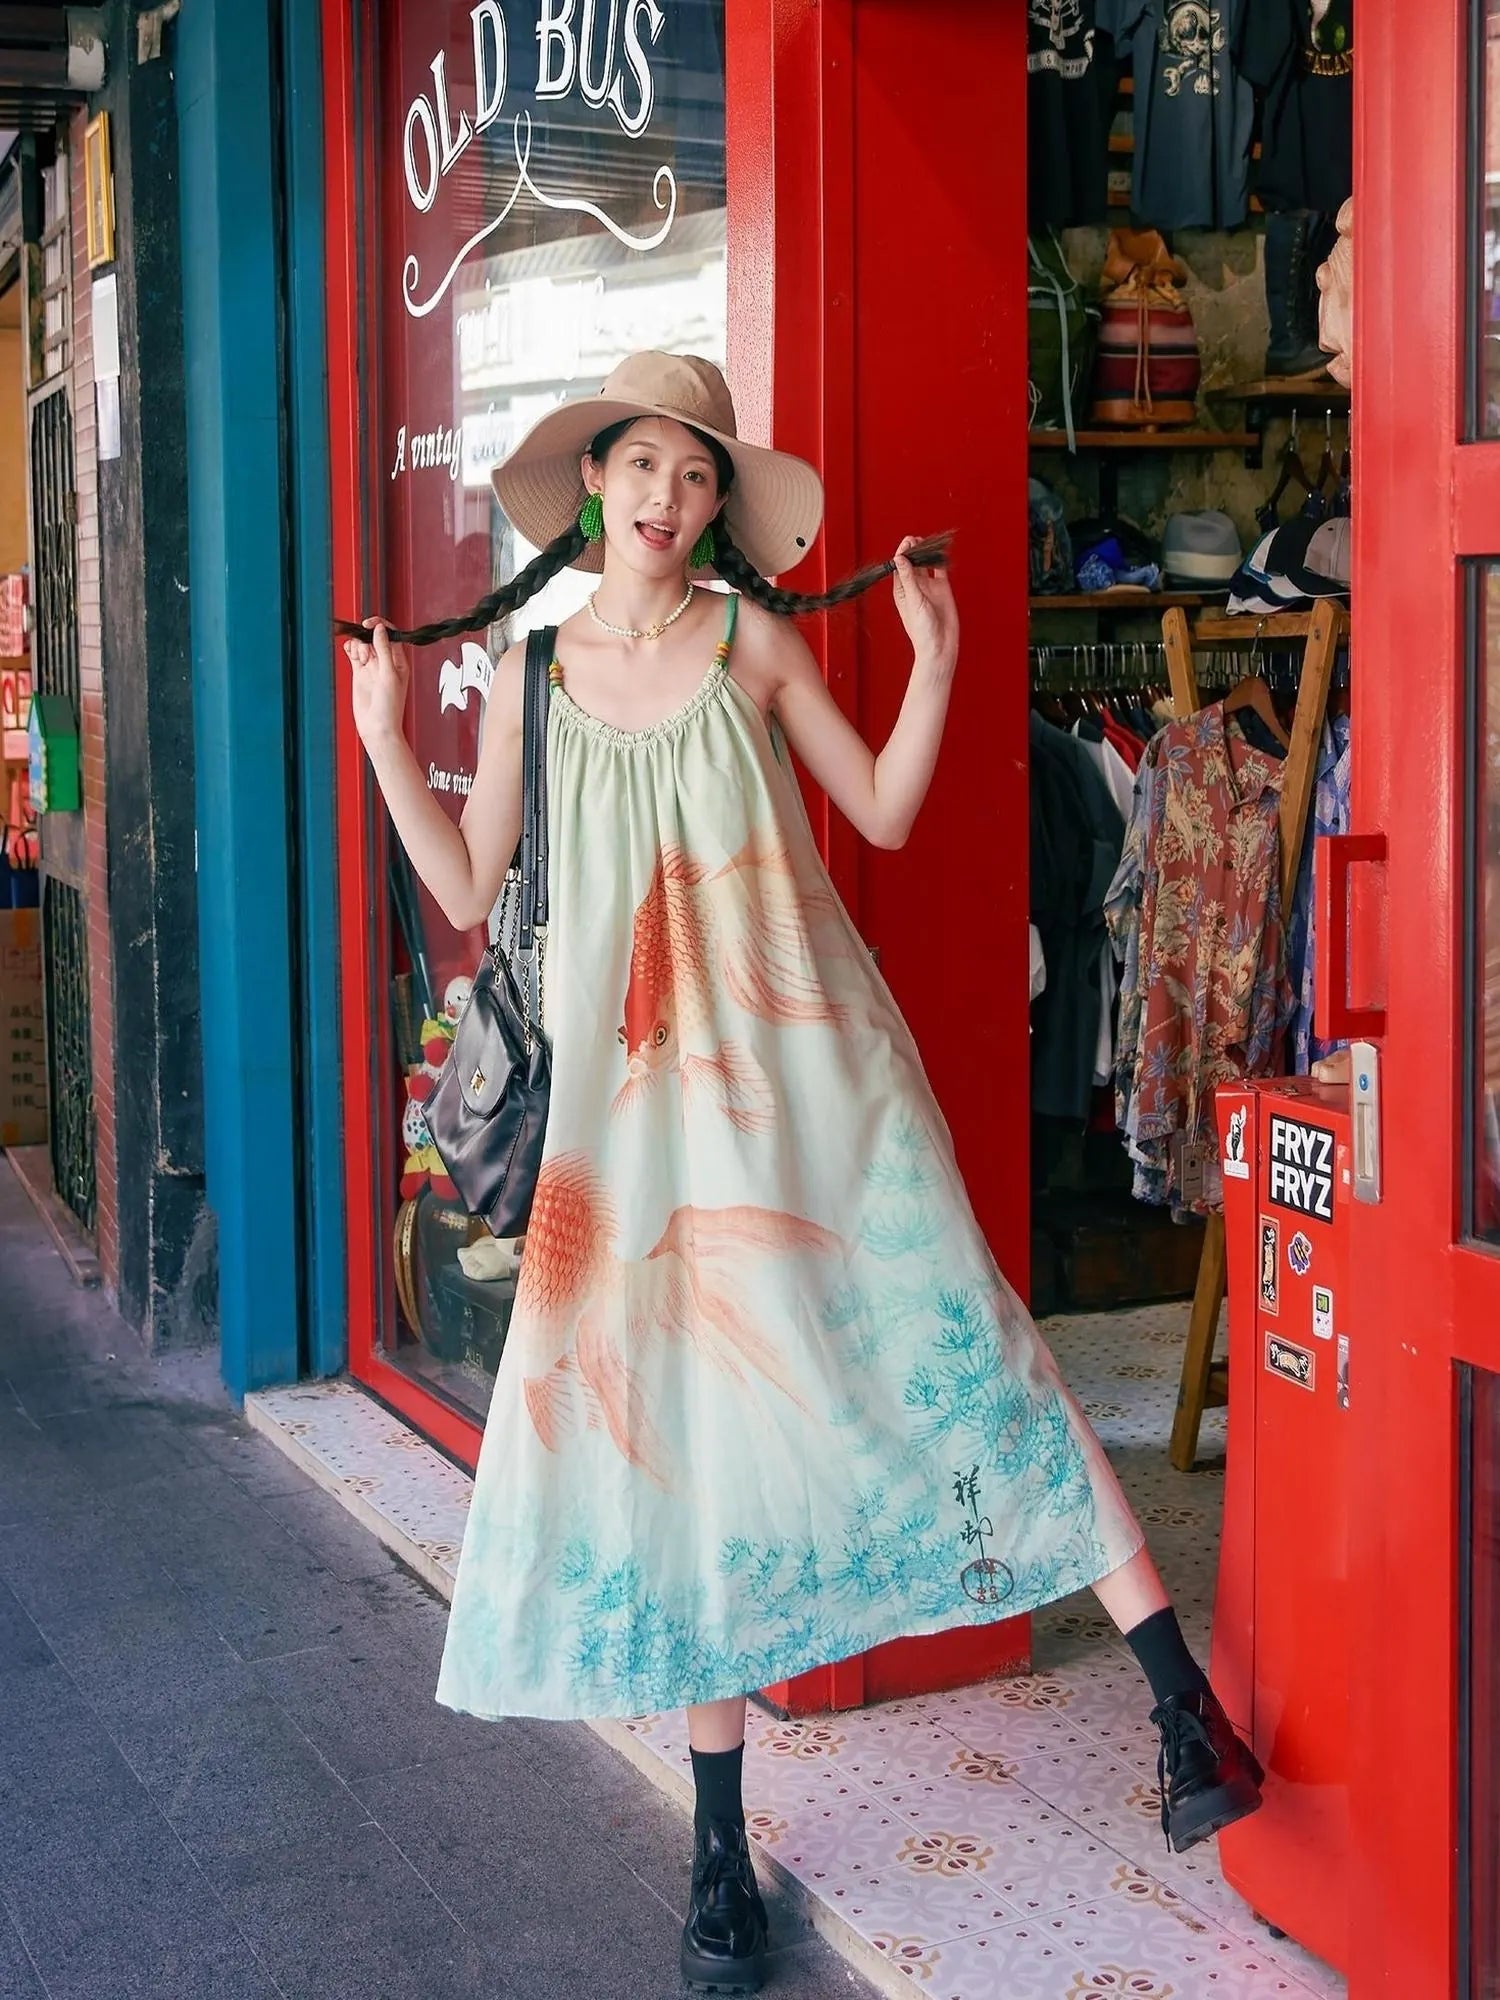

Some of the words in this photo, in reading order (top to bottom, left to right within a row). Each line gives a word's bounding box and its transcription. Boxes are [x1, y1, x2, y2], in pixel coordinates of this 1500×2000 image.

[404, 0, 507, 213] OLD
[534, 0, 665, 138] BUS
[411, 424, 463, 480] vintag
[427, 761, 451, 791] Some
[453, 766, 473, 797] vint
[1271, 1118, 1333, 1174] FRYZ
[1271, 1160, 1332, 1218] FRYZ
